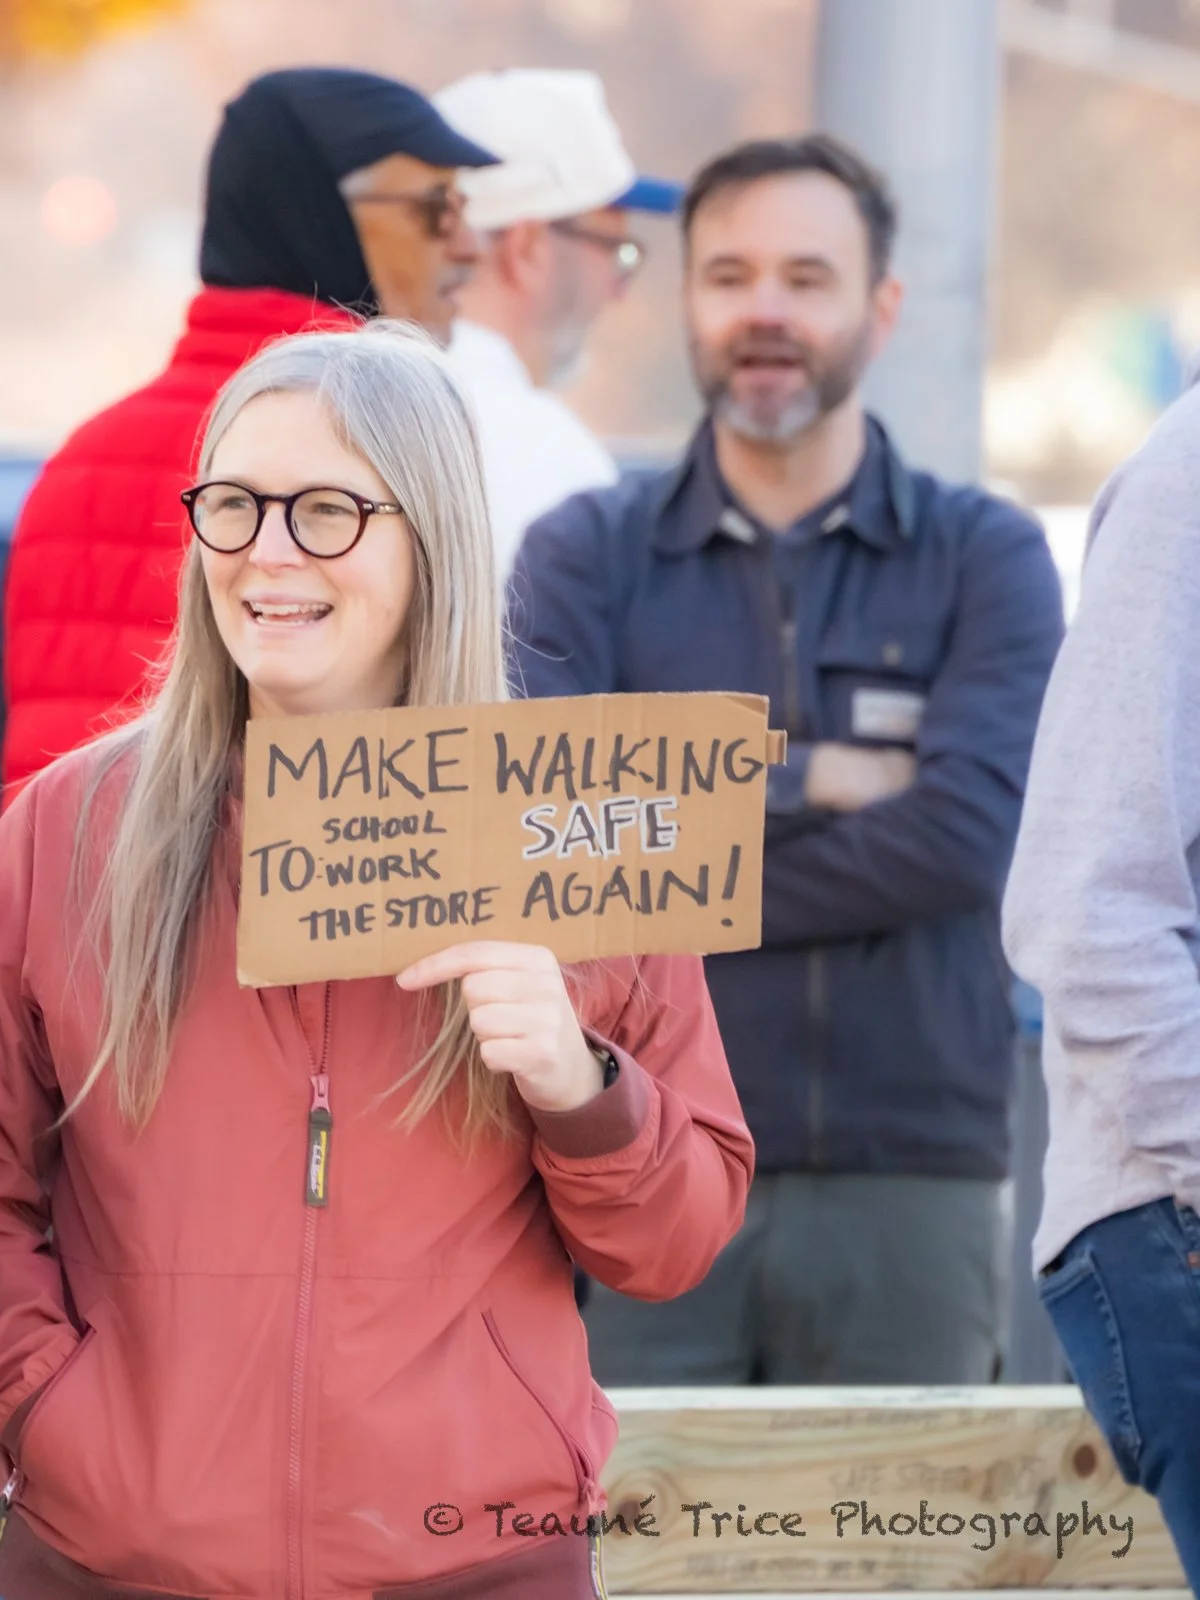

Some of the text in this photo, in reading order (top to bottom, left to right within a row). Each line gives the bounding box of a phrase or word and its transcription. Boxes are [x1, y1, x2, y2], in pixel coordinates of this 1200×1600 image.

[266, 726, 765, 801] MAKE WALKING
[321, 809, 448, 844] SCHOOL
[520, 796, 682, 861] SAFE
[325, 847, 442, 888] WORK
[520, 843, 743, 928] AGAIN!
[298, 885, 502, 942] THE STORE
